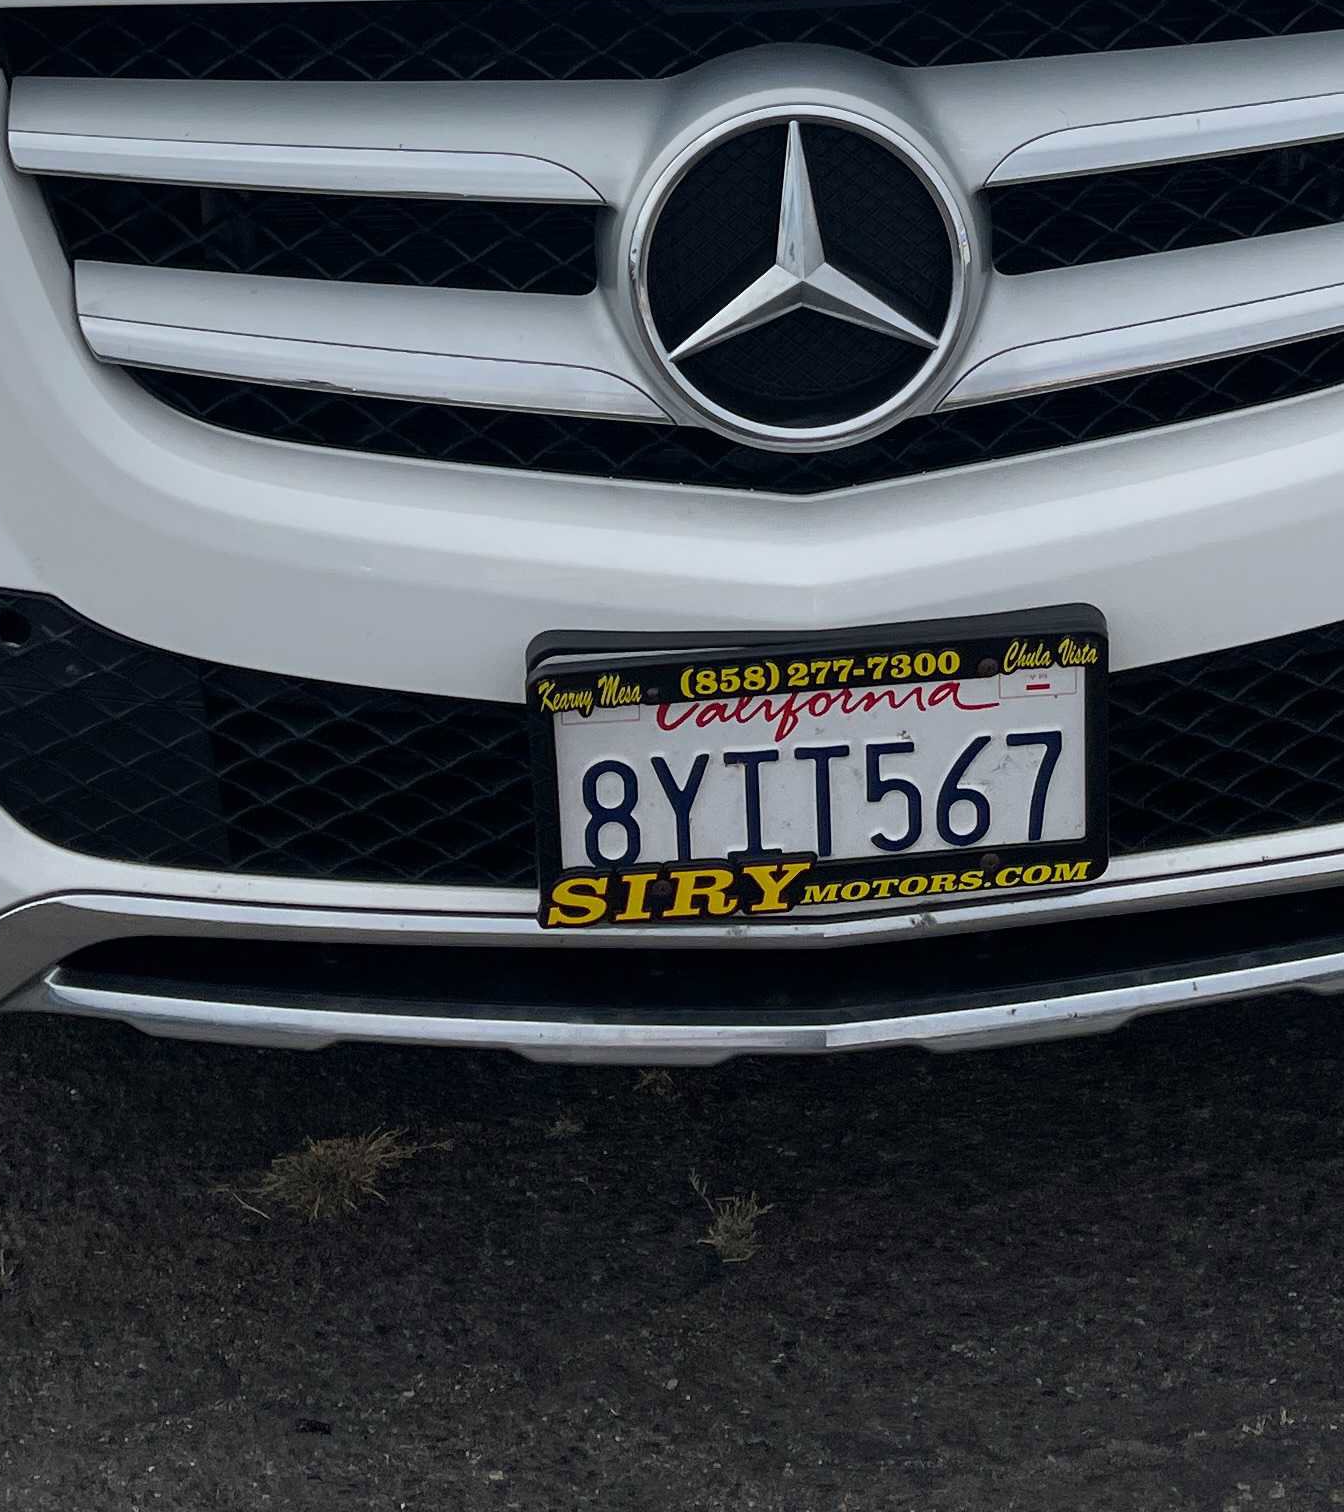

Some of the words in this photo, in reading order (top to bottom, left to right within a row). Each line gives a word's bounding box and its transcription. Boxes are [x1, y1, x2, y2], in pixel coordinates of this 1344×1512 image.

[538, 680, 594, 715] Kearny
[597, 674, 642, 706] Mesa
[680, 662, 780, 699] (858)
[787, 650, 961, 689] 277-7300
[1003, 640, 1052, 673] Chula
[1058, 637, 1098, 666] Vista
[656, 682, 1000, 742] California
[582, 730, 1063, 868] 8YIT567
[547, 862, 811, 927] SIRY
[800, 860, 1092, 905] MOTORS.COM
